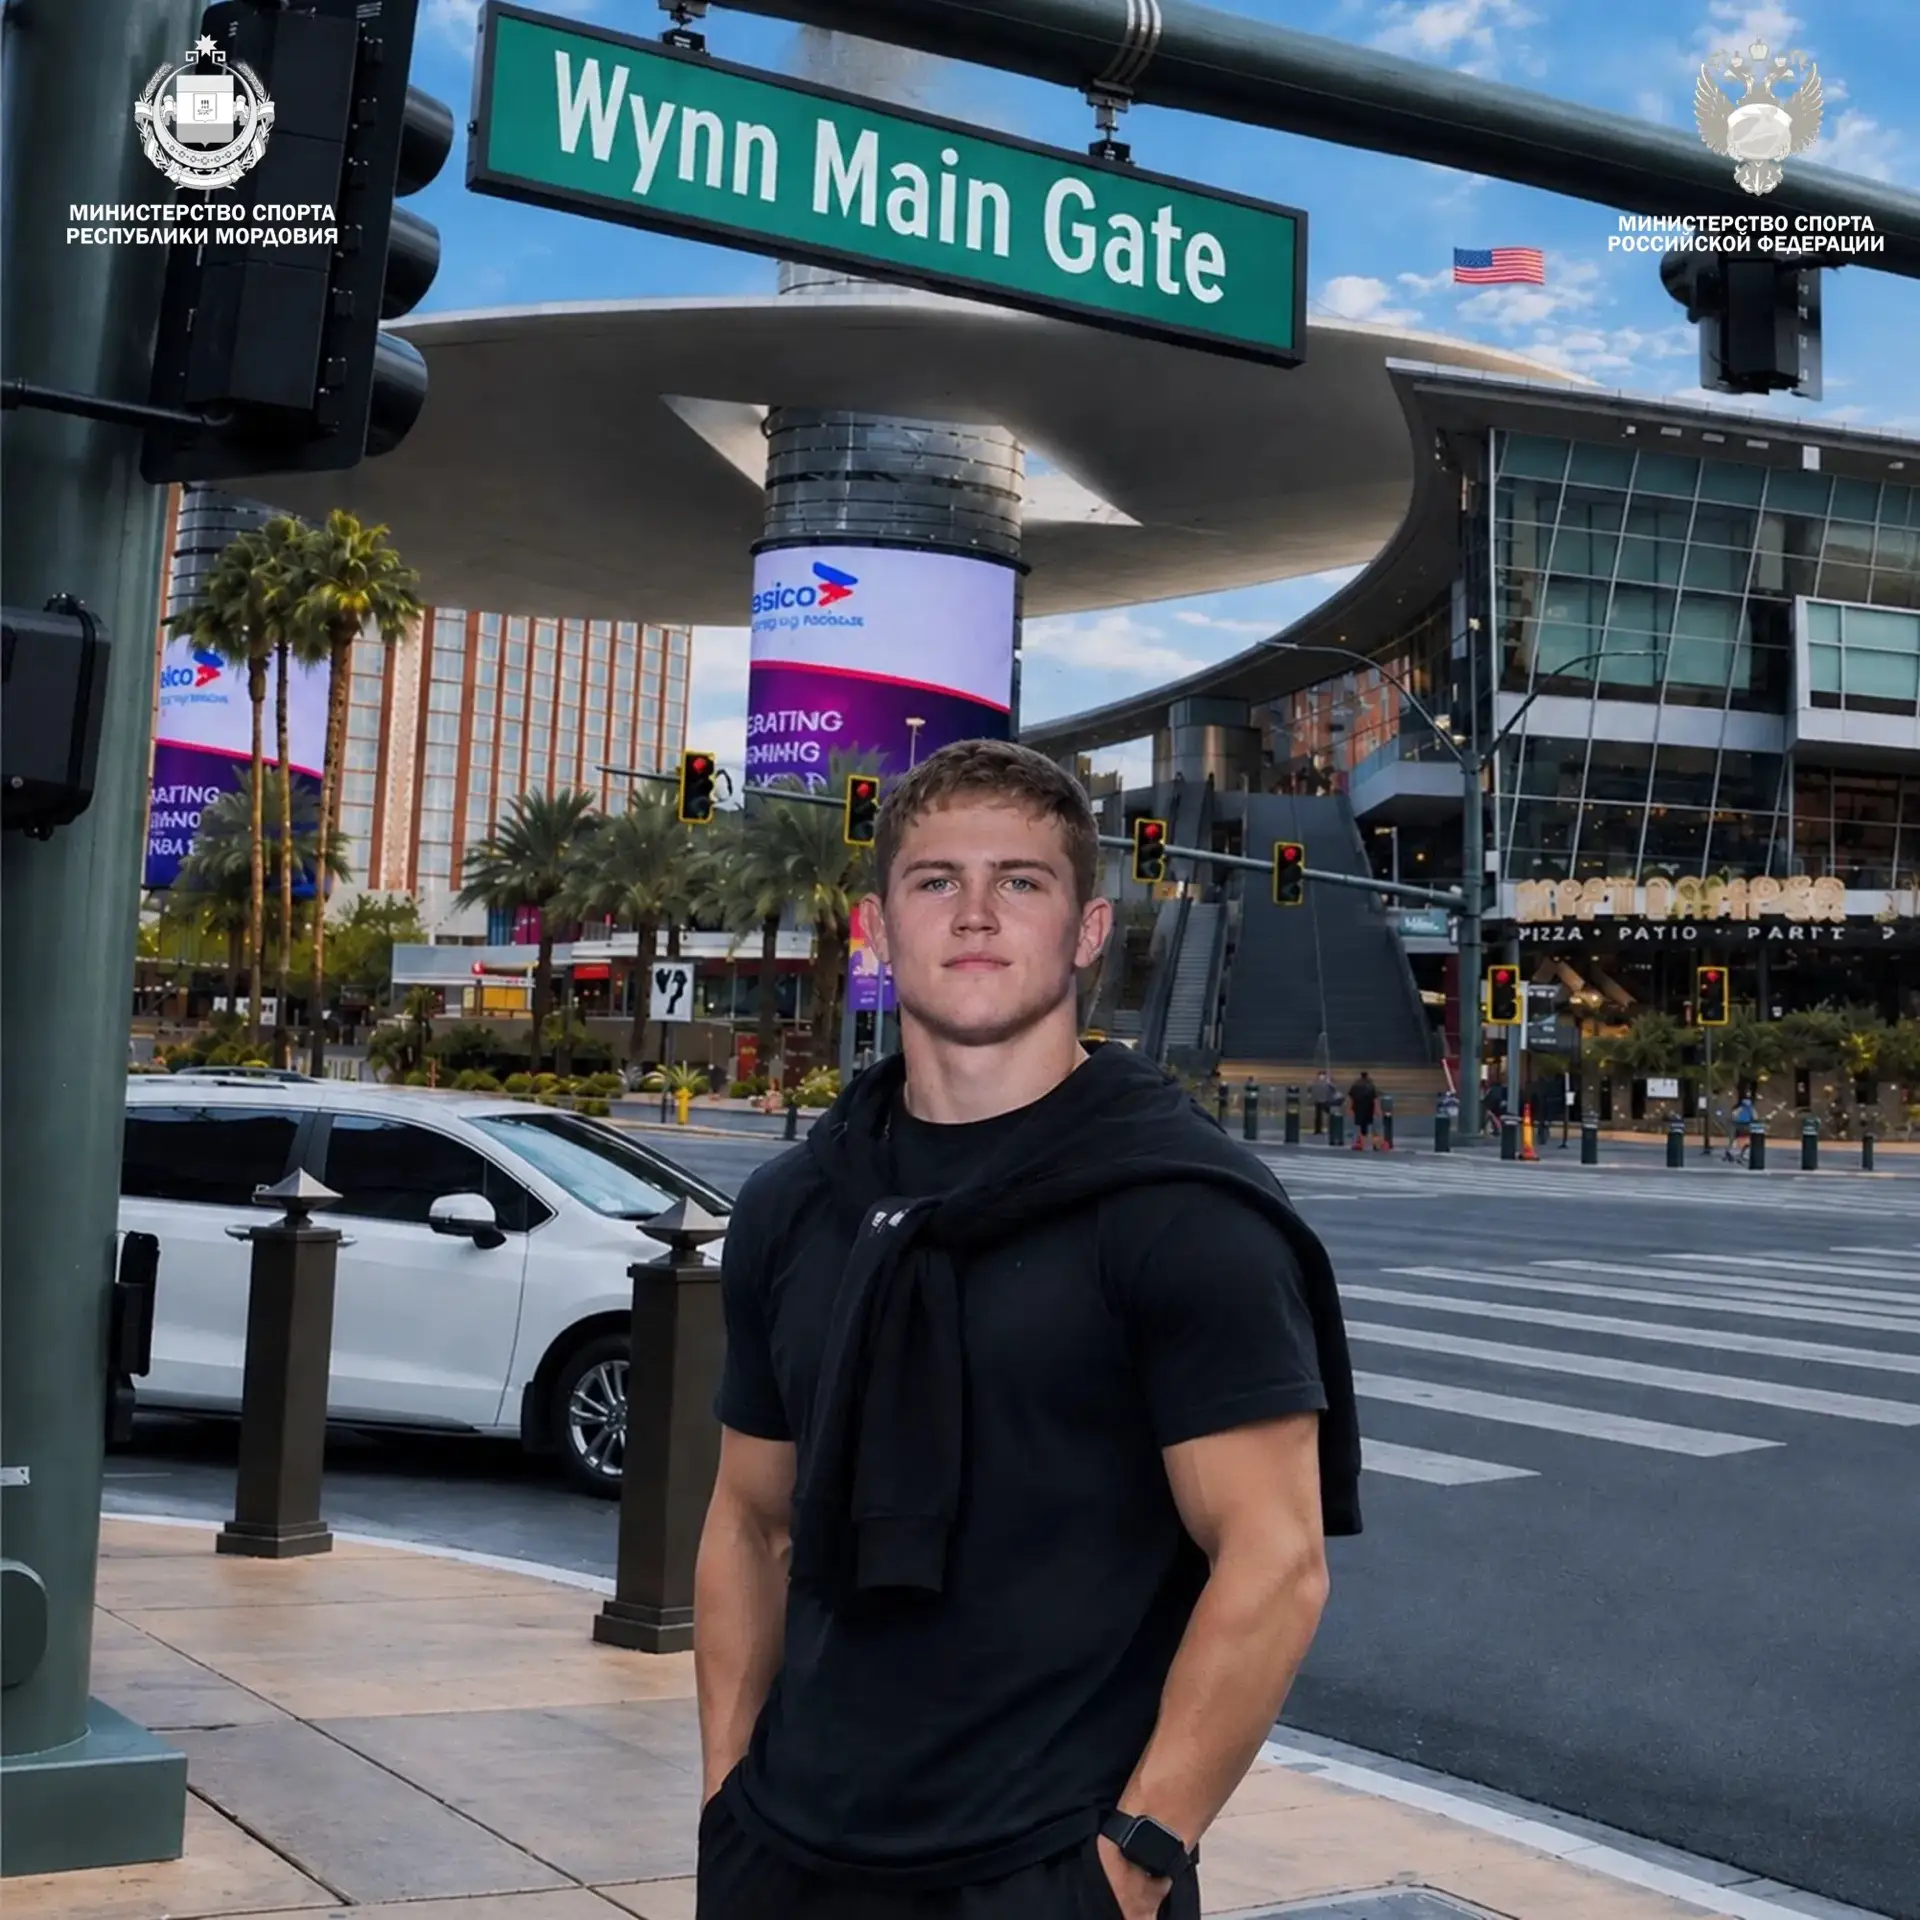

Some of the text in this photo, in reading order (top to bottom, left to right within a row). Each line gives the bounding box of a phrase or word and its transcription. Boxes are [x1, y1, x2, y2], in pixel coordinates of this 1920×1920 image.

[553, 49, 1227, 305] Wynn Main Gate
